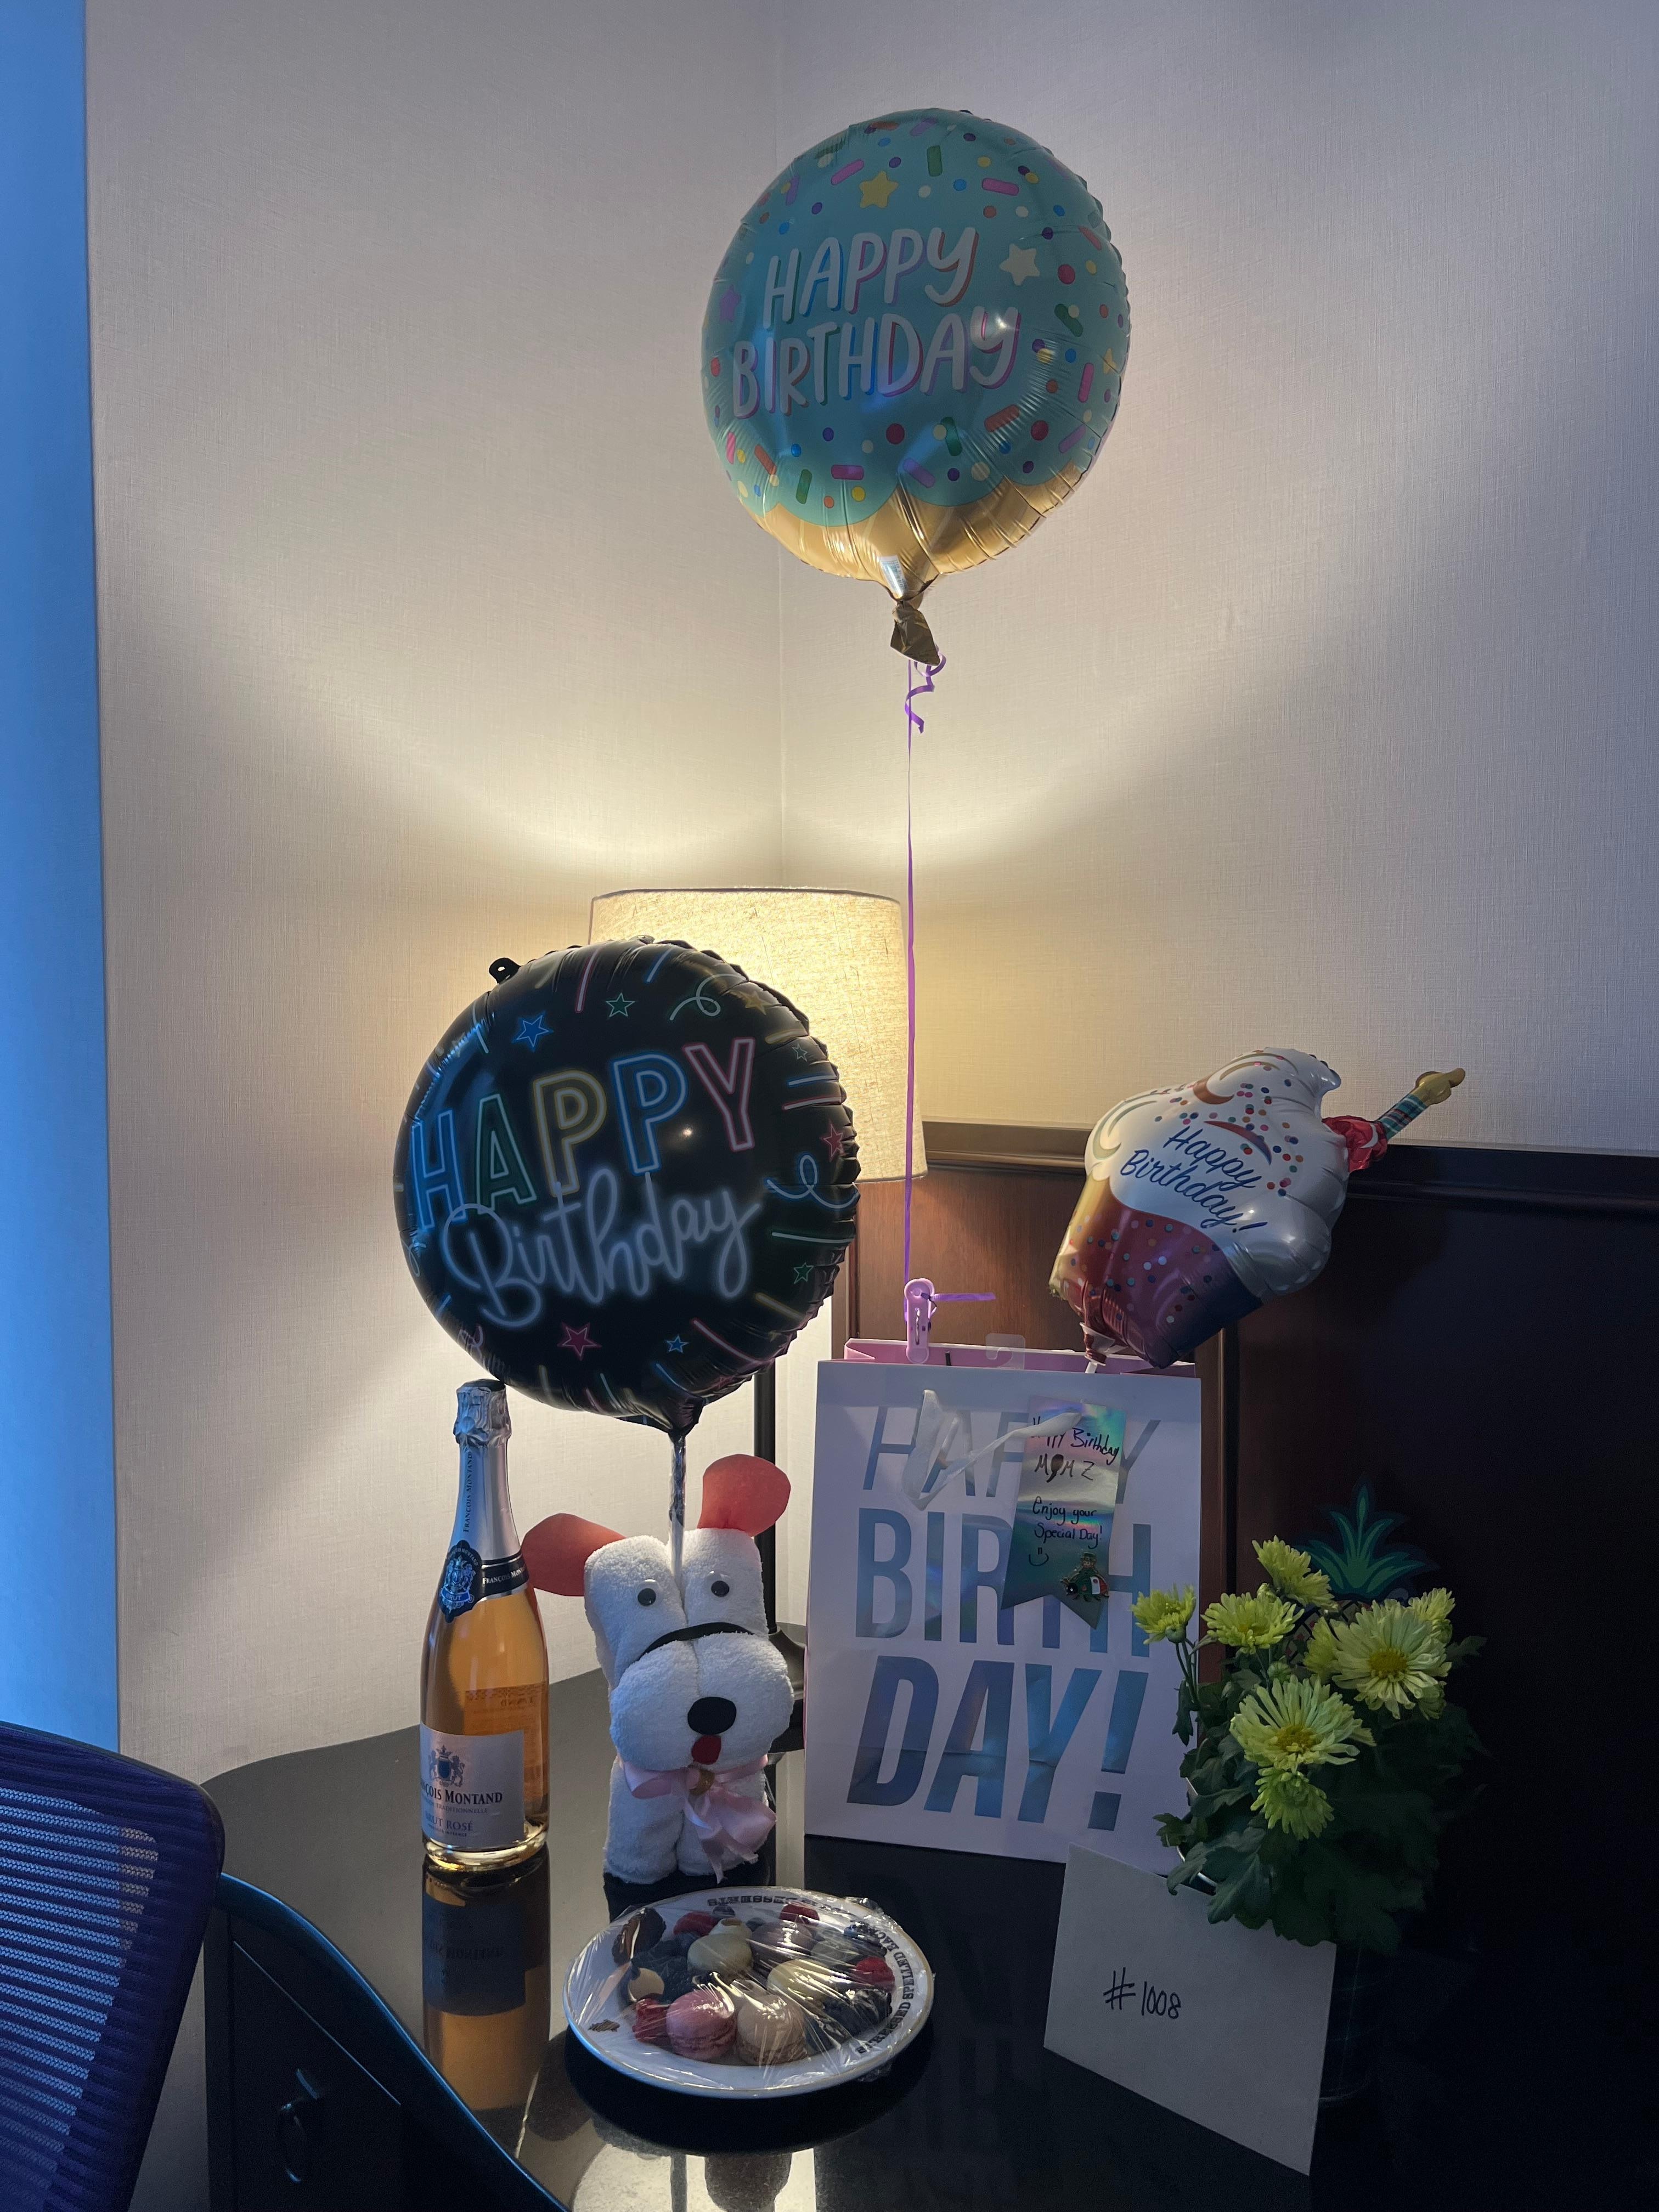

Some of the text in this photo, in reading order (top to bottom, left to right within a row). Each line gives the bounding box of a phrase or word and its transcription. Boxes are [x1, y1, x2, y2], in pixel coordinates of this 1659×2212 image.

[763, 227, 979, 330] HAPPY
[732, 306, 1021, 419] BIRTHDAY
[410, 1037, 756, 1233] HAPPY
[1163, 1126, 1262, 1191] Happy
[1120, 1149, 1268, 1233] Birthday!
[442, 1167, 761, 1329] Birthday
[863, 1406, 1161, 1504] HAPY
[1070, 1427, 1120, 1466] Birthday
[1081, 1460, 1095, 1481] Z
[1034, 1522, 1103, 1549] Special Day!
[1073, 1509, 1097, 1525] your
[855, 1508, 1152, 1657] BIRH
[847, 1655, 1148, 1831] DAY!
[425, 1812, 443, 1827] BRUT
[447, 1820, 474, 1831] ROSÉ
[445, 1789, 503, 1805] MONTAND
[893, 1951, 915, 2000] SPELLED
